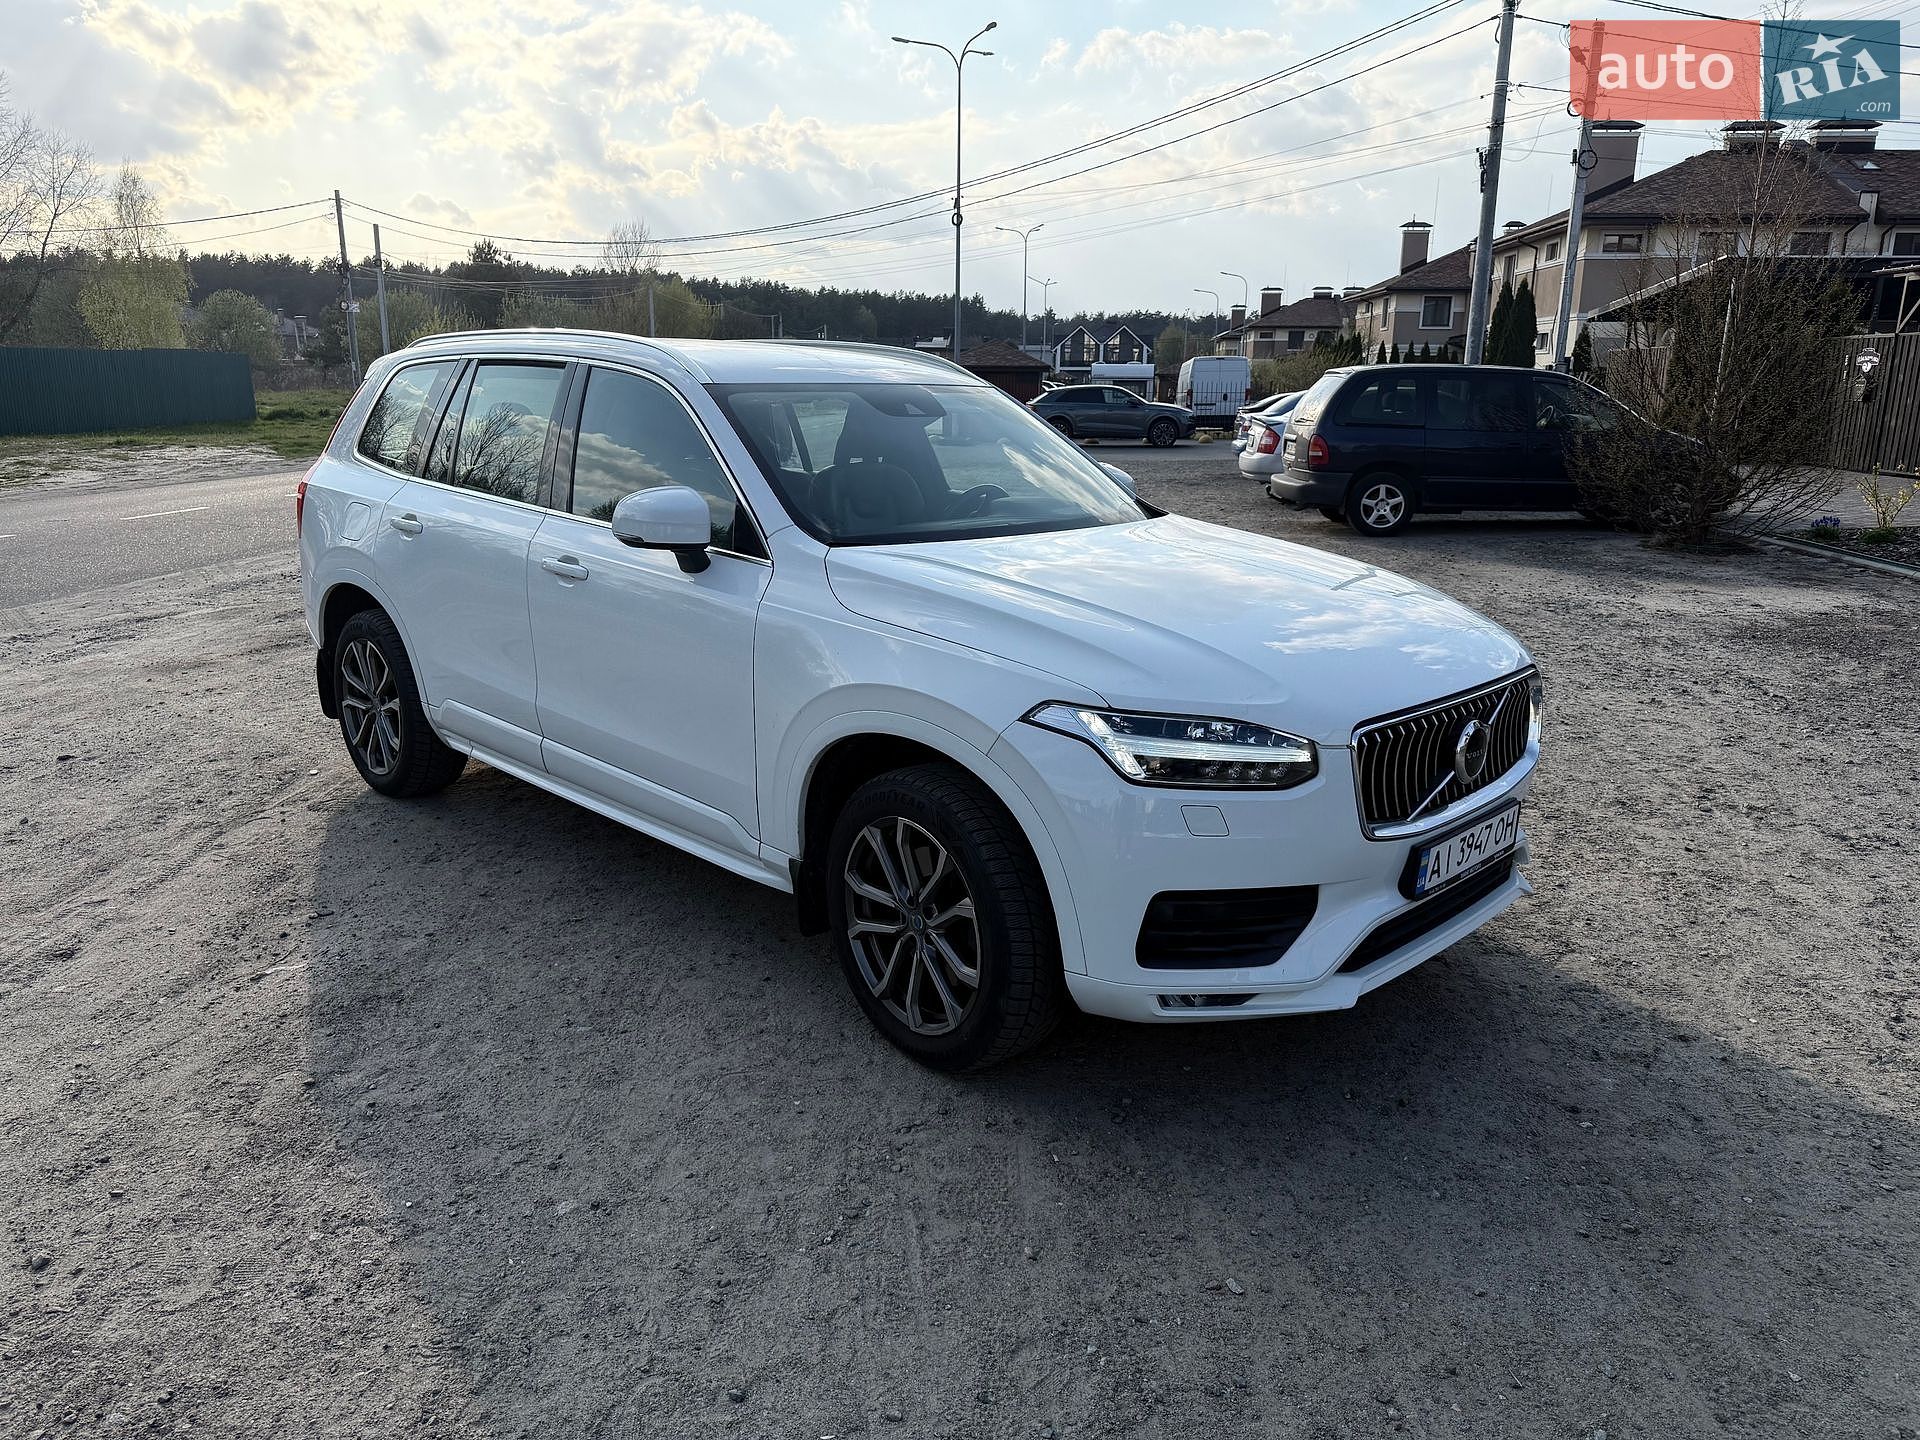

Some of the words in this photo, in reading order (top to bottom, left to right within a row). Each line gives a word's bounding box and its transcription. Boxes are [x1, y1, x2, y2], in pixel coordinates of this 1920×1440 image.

[1428, 844, 1452, 883] AI
[1457, 823, 1493, 866] 3947
[1495, 810, 1516, 846] OH
